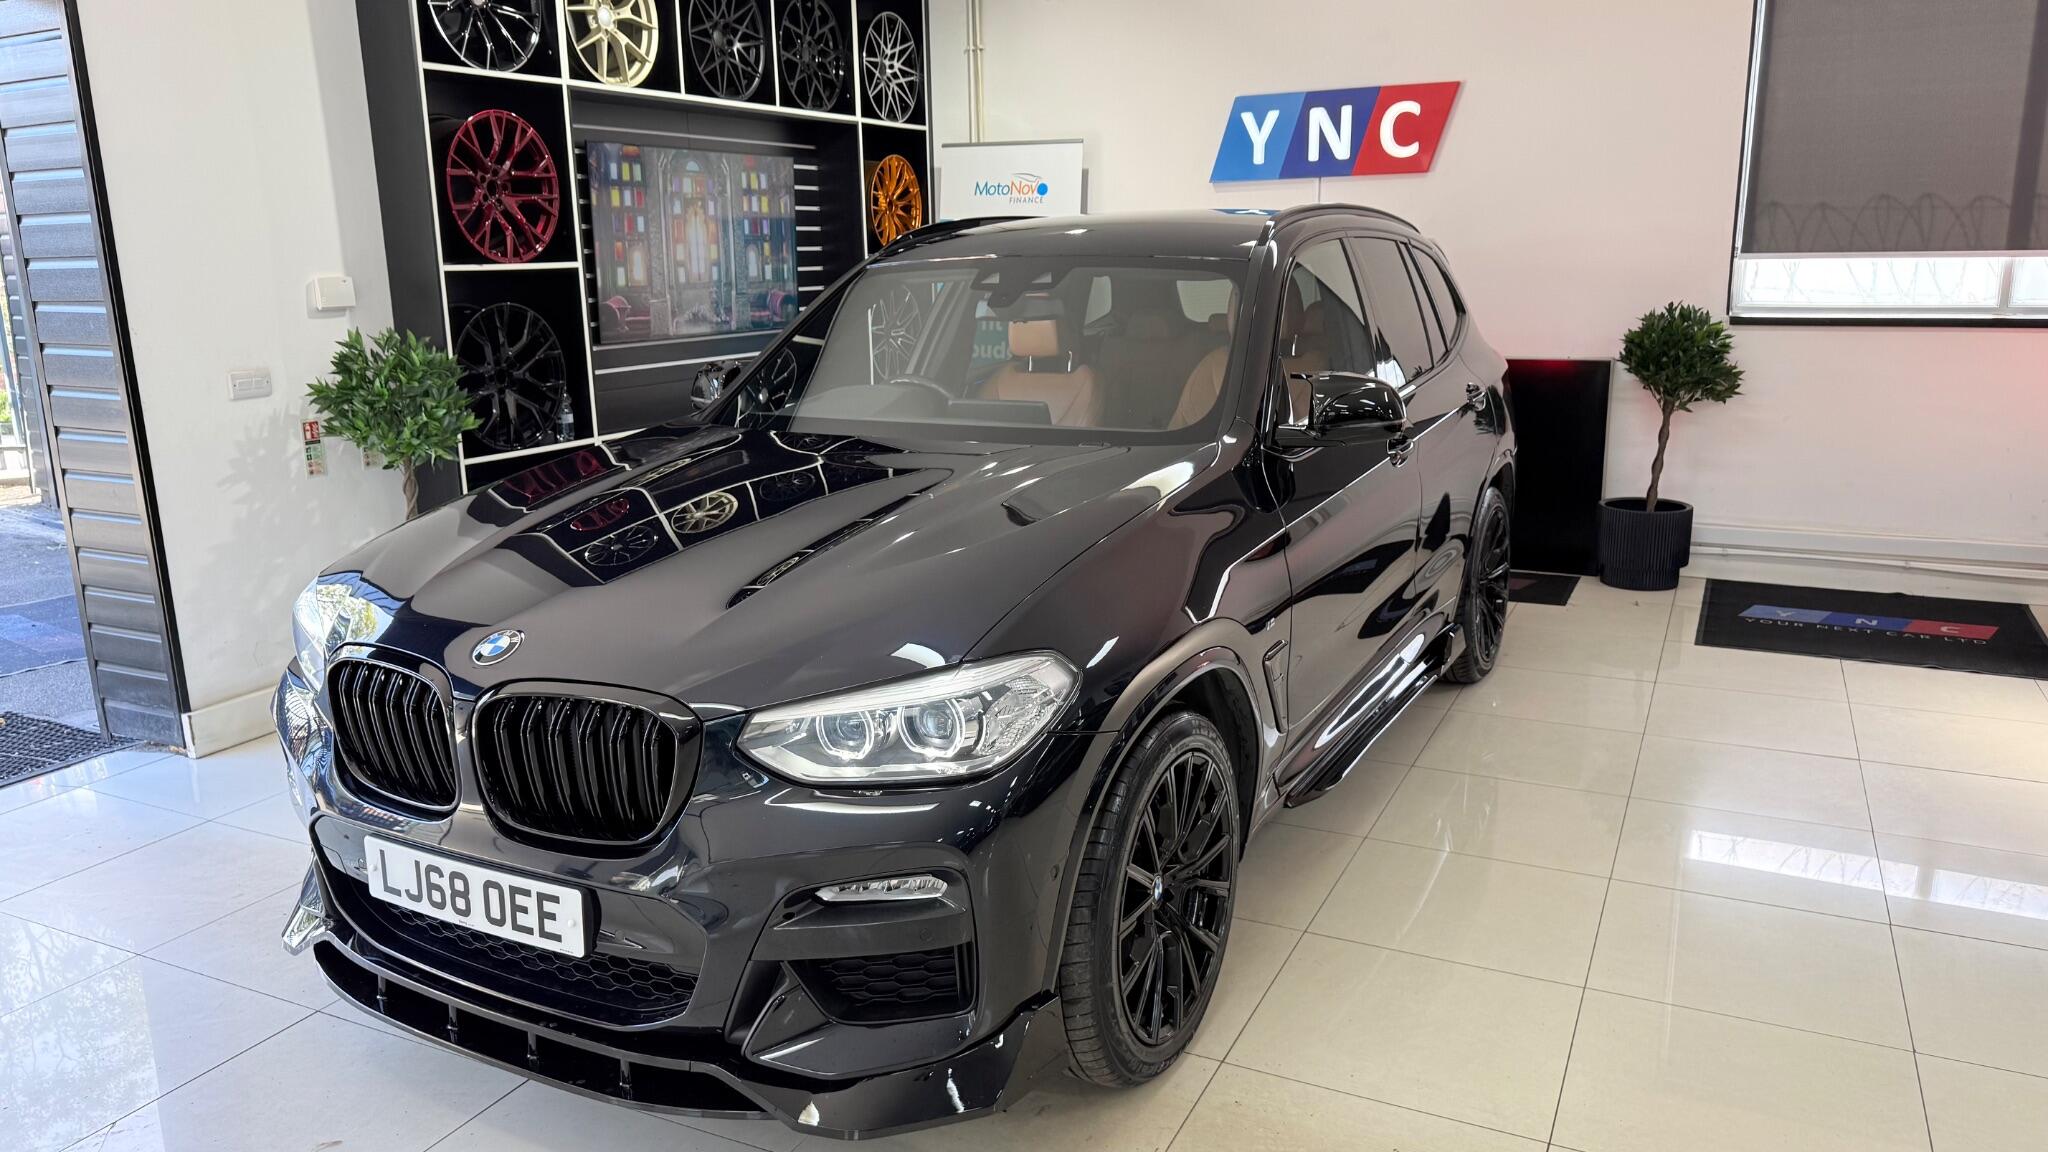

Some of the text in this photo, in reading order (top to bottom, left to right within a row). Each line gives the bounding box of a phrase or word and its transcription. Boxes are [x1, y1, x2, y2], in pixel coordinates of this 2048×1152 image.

[1240, 100, 1421, 165] YNC
[974, 179, 1048, 196] MotoNovo
[1008, 196, 1044, 205] FINANCE
[1745, 618, 1986, 645] YOUR NEXT CAR LTD
[379, 848, 563, 943] LJ68 OEE
